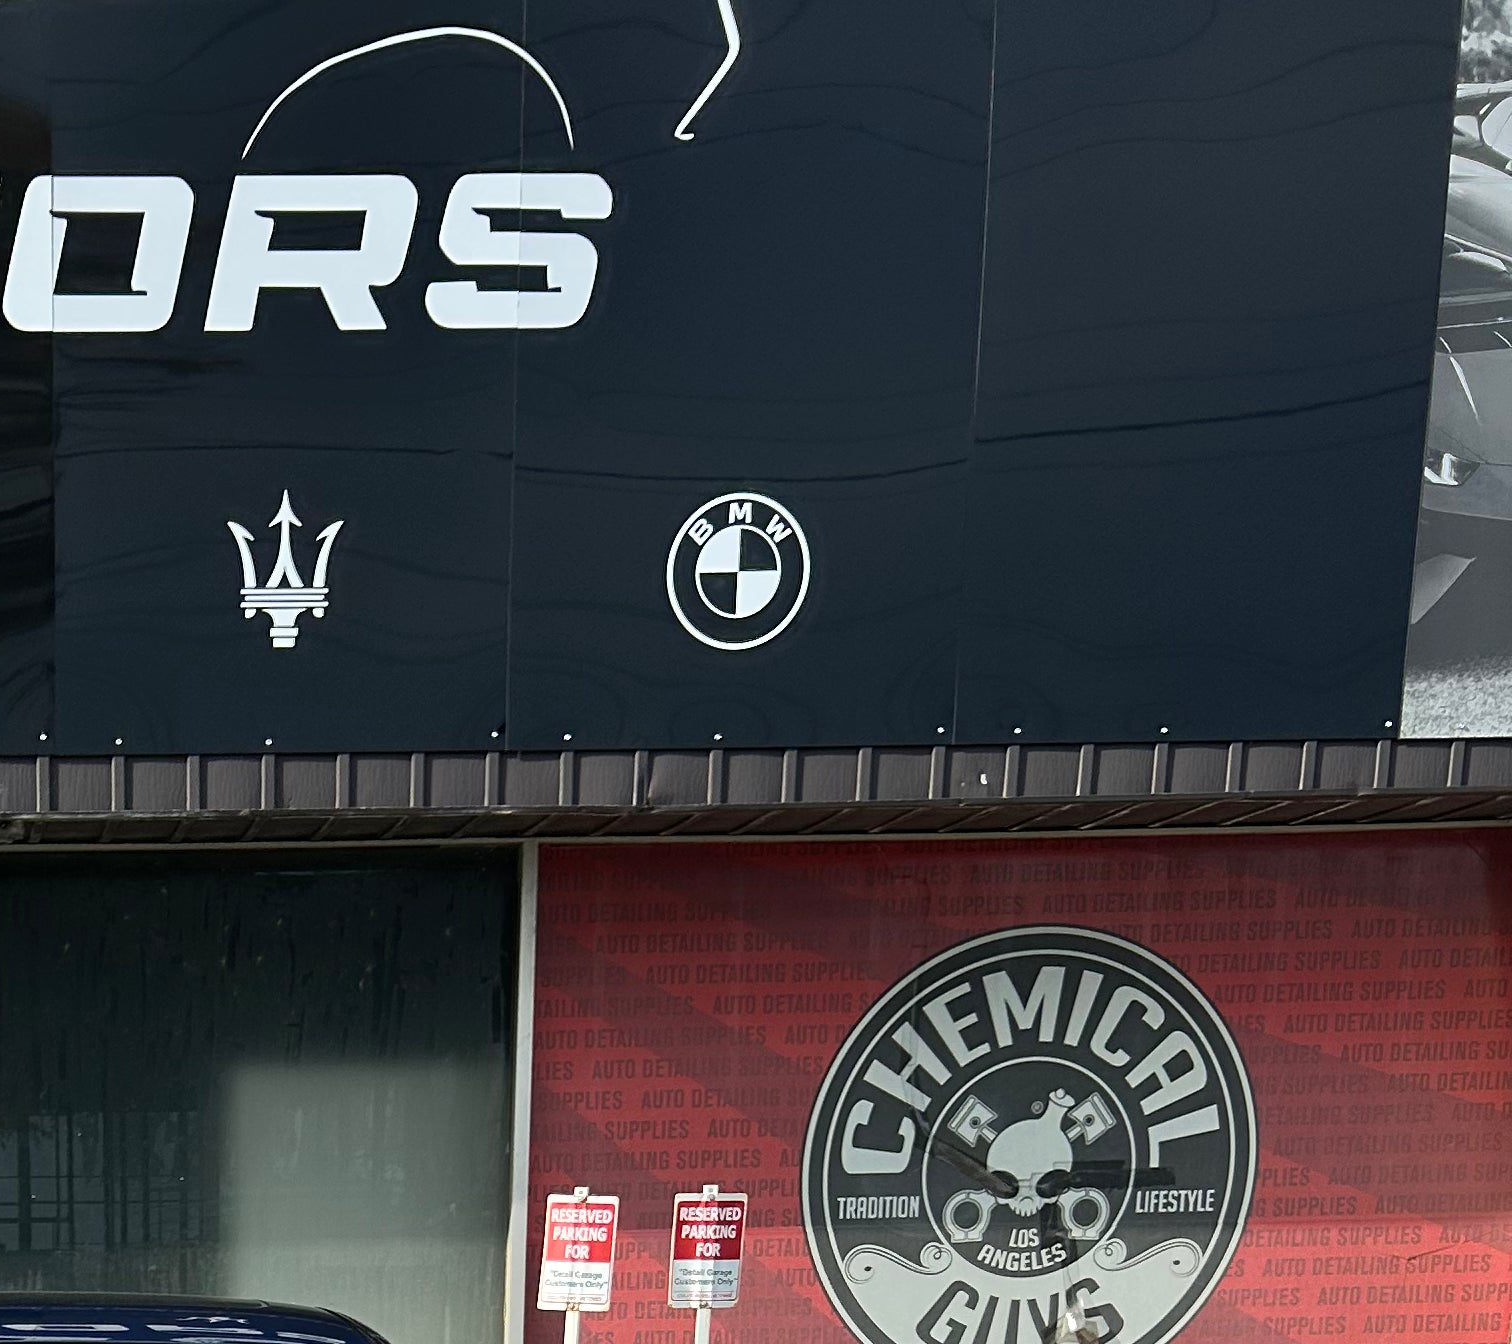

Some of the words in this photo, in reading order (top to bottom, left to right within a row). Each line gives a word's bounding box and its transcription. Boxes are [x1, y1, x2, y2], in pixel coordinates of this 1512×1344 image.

[687, 502, 793, 547] BMW
[1150, 922, 1240, 944] DETAILING
[1247, 919, 1333, 940] SUPPLIES
[1350, 919, 1396, 939] AUTO
[646, 933, 736, 954] DETAILING
[1198, 951, 1288, 973] DETAILING
[1294, 950, 1381, 971] SUPPLIES
[1398, 948, 1443, 969] AUTO
[645, 964, 688, 984] AUTO
[696, 962, 786, 984] DETAILING
[1214, 984, 1257, 1004] AUTO
[1263, 981, 1354, 1003] DETAILING
[1360, 980, 1446, 1001] SUPPLIES
[1464, 978, 1508, 998] AUTO
[713, 995, 755, 1015] AUTO
[762, 993, 852, 1014] DETAILING
[1284, 1013, 1328, 1034] AUTO
[1334, 1011, 1424, 1032] DETAILING
[584, 1028, 676, 1049] DETAILING
[784, 1024, 828, 1045] AUTO
[1341, 1043, 1384, 1063] AUTO
[1390, 1042, 1480, 1062] DETAILING
[592, 1059, 636, 1080] AUTO
[841, 966, 1220, 1175] CHEMICAL
[1389, 1072, 1432, 1092] AUTO
[641, 1088, 685, 1109] AUTO
[604, 1120, 690, 1140] SUPPLIES
[707, 1119, 751, 1140] AUTO
[1417, 1132, 1503, 1151] SUPPLIES
[580, 1151, 670, 1172] DETAILING
[676, 1149, 762, 1169] SUPPLIES
[1379, 1163, 1468, 1185] DETAILING
[837, 1196, 920, 1219] TRADITION
[1135, 1189, 1216, 1214] LIFESTYLE
[1272, 1196, 1357, 1217] SUPPLIES
[1375, 1193, 1419, 1214] AUTO
[551, 1207, 613, 1224] RESERVED
[679, 1206, 742, 1222] RESERVED
[552, 1226, 608, 1242] PARKING
[681, 1224, 737, 1239] PARKING
[1009, 1227, 1040, 1248] LOS
[1337, 1225, 1421, 1246] SUPPLIES
[565, 1243, 590, 1260] FOR
[695, 1242, 721, 1257] FOR
[976, 1243, 1067, 1272] ANGELES
[1262, 1257, 1306, 1277] AUTO
[1312, 1255, 1399, 1276] DETAILING
[1406, 1253, 1491, 1274] SUPPLIES
[1317, 1286, 1361, 1306] AUTO
[1366, 1283, 1455, 1304] DETAILING
[1264, 1316, 1347, 1336] SUPPLIES
[1363, 1314, 1407, 1334] AUTO
[1413, 1312, 1502, 1332] DETAILING
